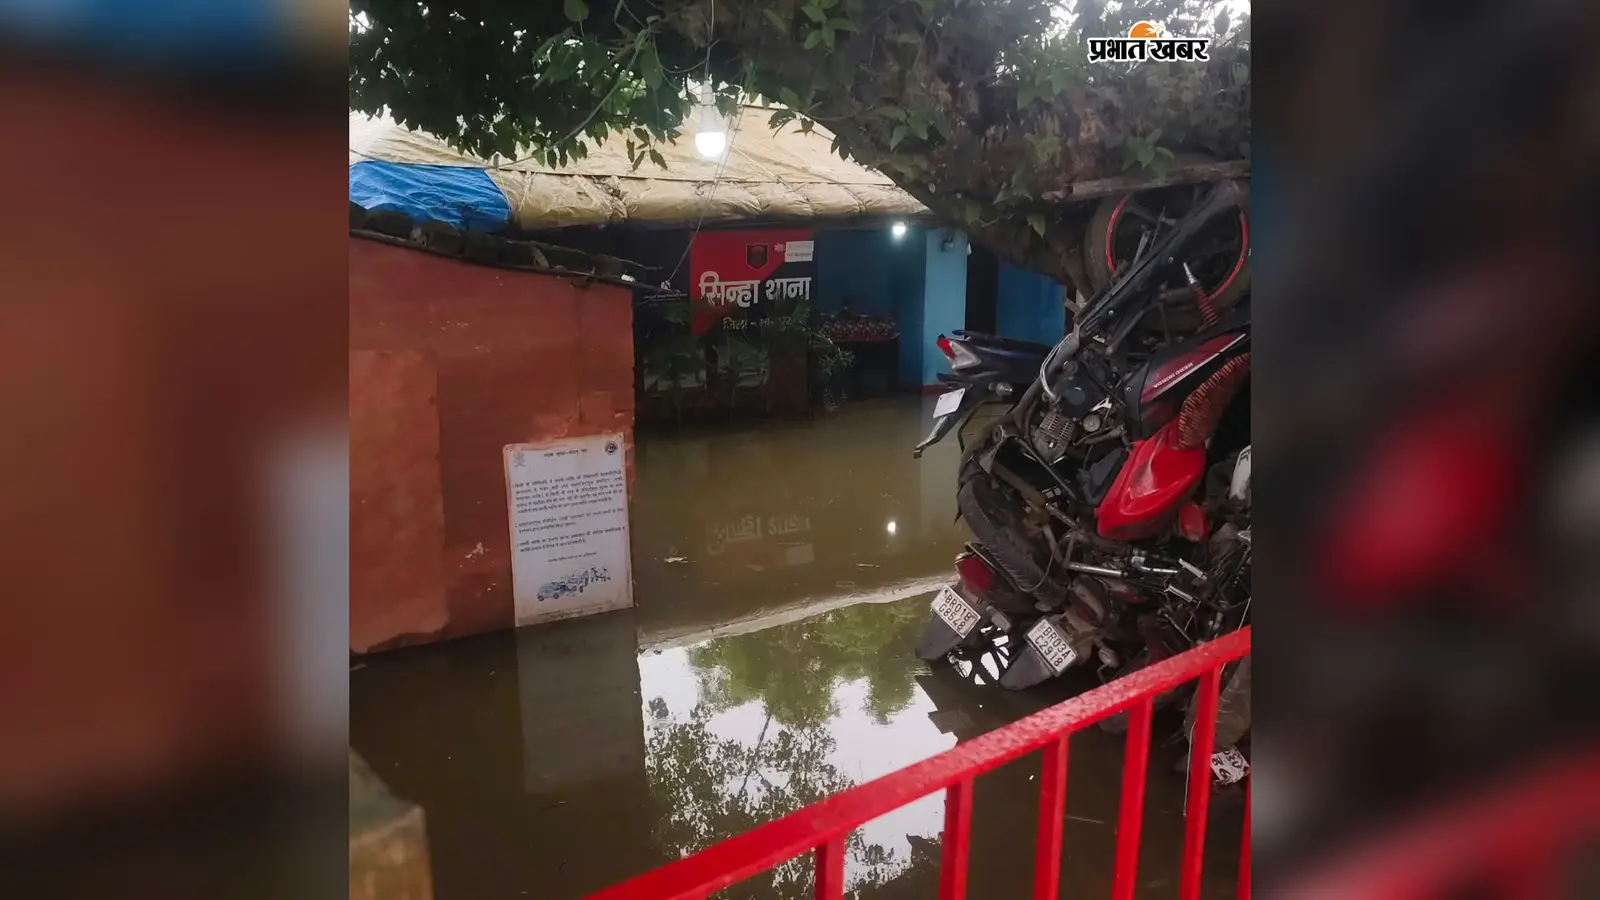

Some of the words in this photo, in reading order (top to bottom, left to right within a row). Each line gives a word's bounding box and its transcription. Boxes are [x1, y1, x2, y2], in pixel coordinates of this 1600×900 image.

[699, 271, 761, 308] सिन्हा
[766, 276, 812, 301] थाना
[944, 594, 972, 622] BR01B
[1034, 635, 1064, 667] C2918
[1042, 627, 1071, 660] BR03A
